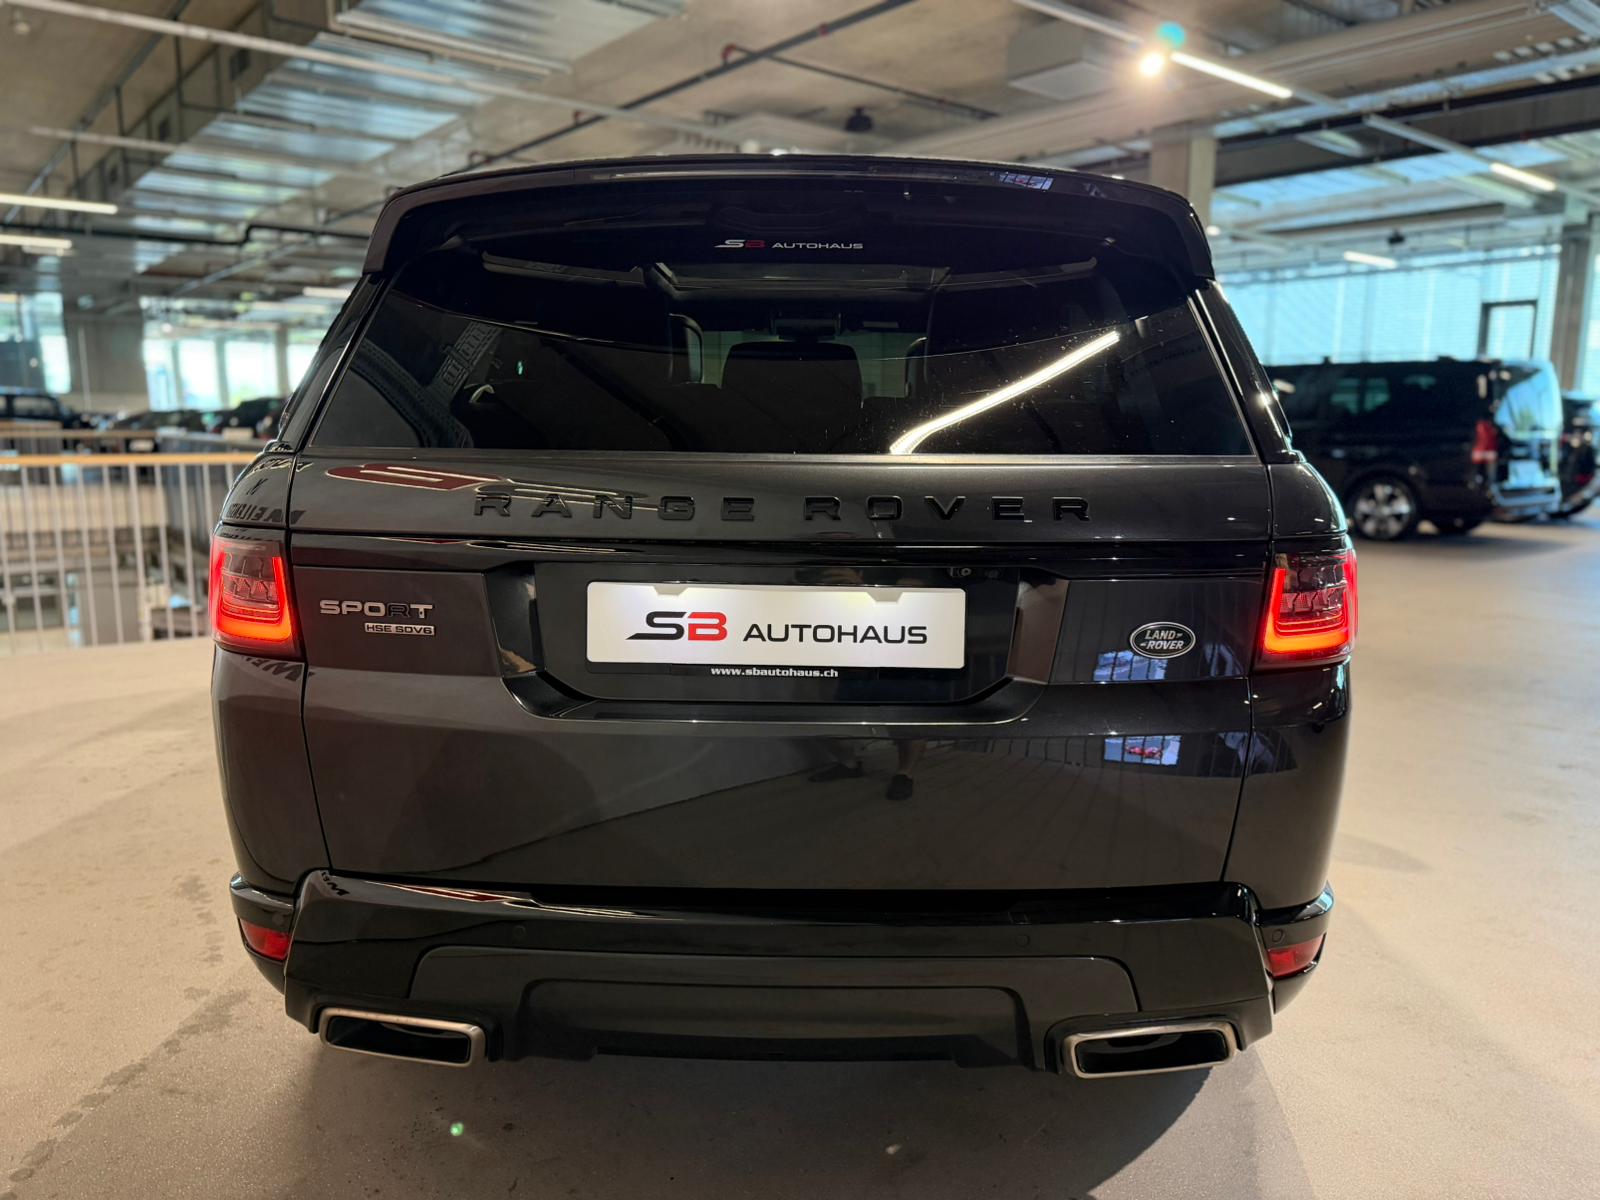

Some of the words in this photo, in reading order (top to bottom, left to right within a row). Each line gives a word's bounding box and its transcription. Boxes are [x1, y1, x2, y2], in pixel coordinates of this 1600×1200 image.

[714, 239, 767, 249] SB
[771, 242, 864, 250] AUTOHAUS
[473, 493, 756, 522] RANGE
[803, 495, 1092, 521] ROVER
[319, 599, 434, 619] SPORT
[366, 623, 393, 633] HSE
[395, 625, 433, 635] SDV6
[625, 611, 729, 642] SB
[742, 623, 928, 645] AUTOHAUS
[1144, 630, 1177, 640] LAND
[1145, 640, 1185, 650] ROVER
[710, 667, 839, 679] www.sbautohaus.ch
